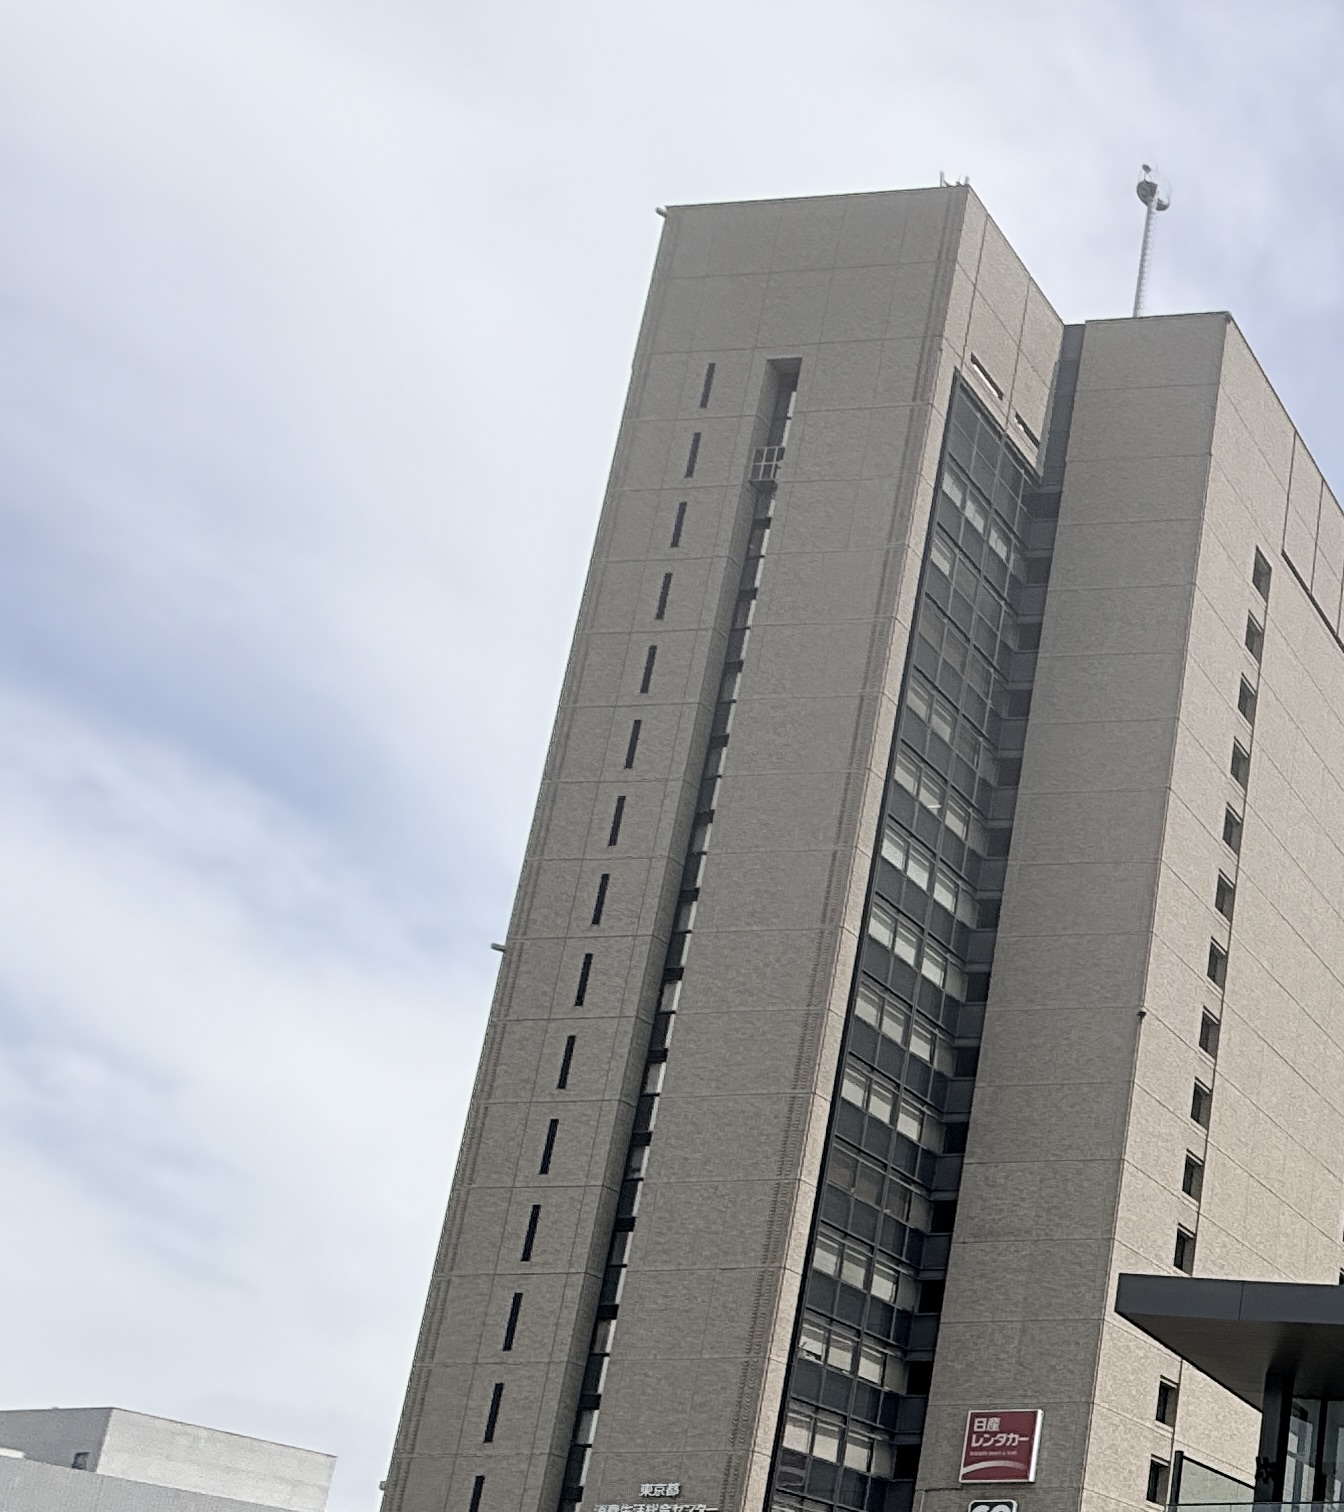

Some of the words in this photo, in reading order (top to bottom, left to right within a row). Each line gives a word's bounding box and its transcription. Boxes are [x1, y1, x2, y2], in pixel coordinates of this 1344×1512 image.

[973, 1417, 1000, 1432] 日産
[971, 1433, 1029, 1447] レンタカー
[639, 1483, 680, 1497] 東京都
